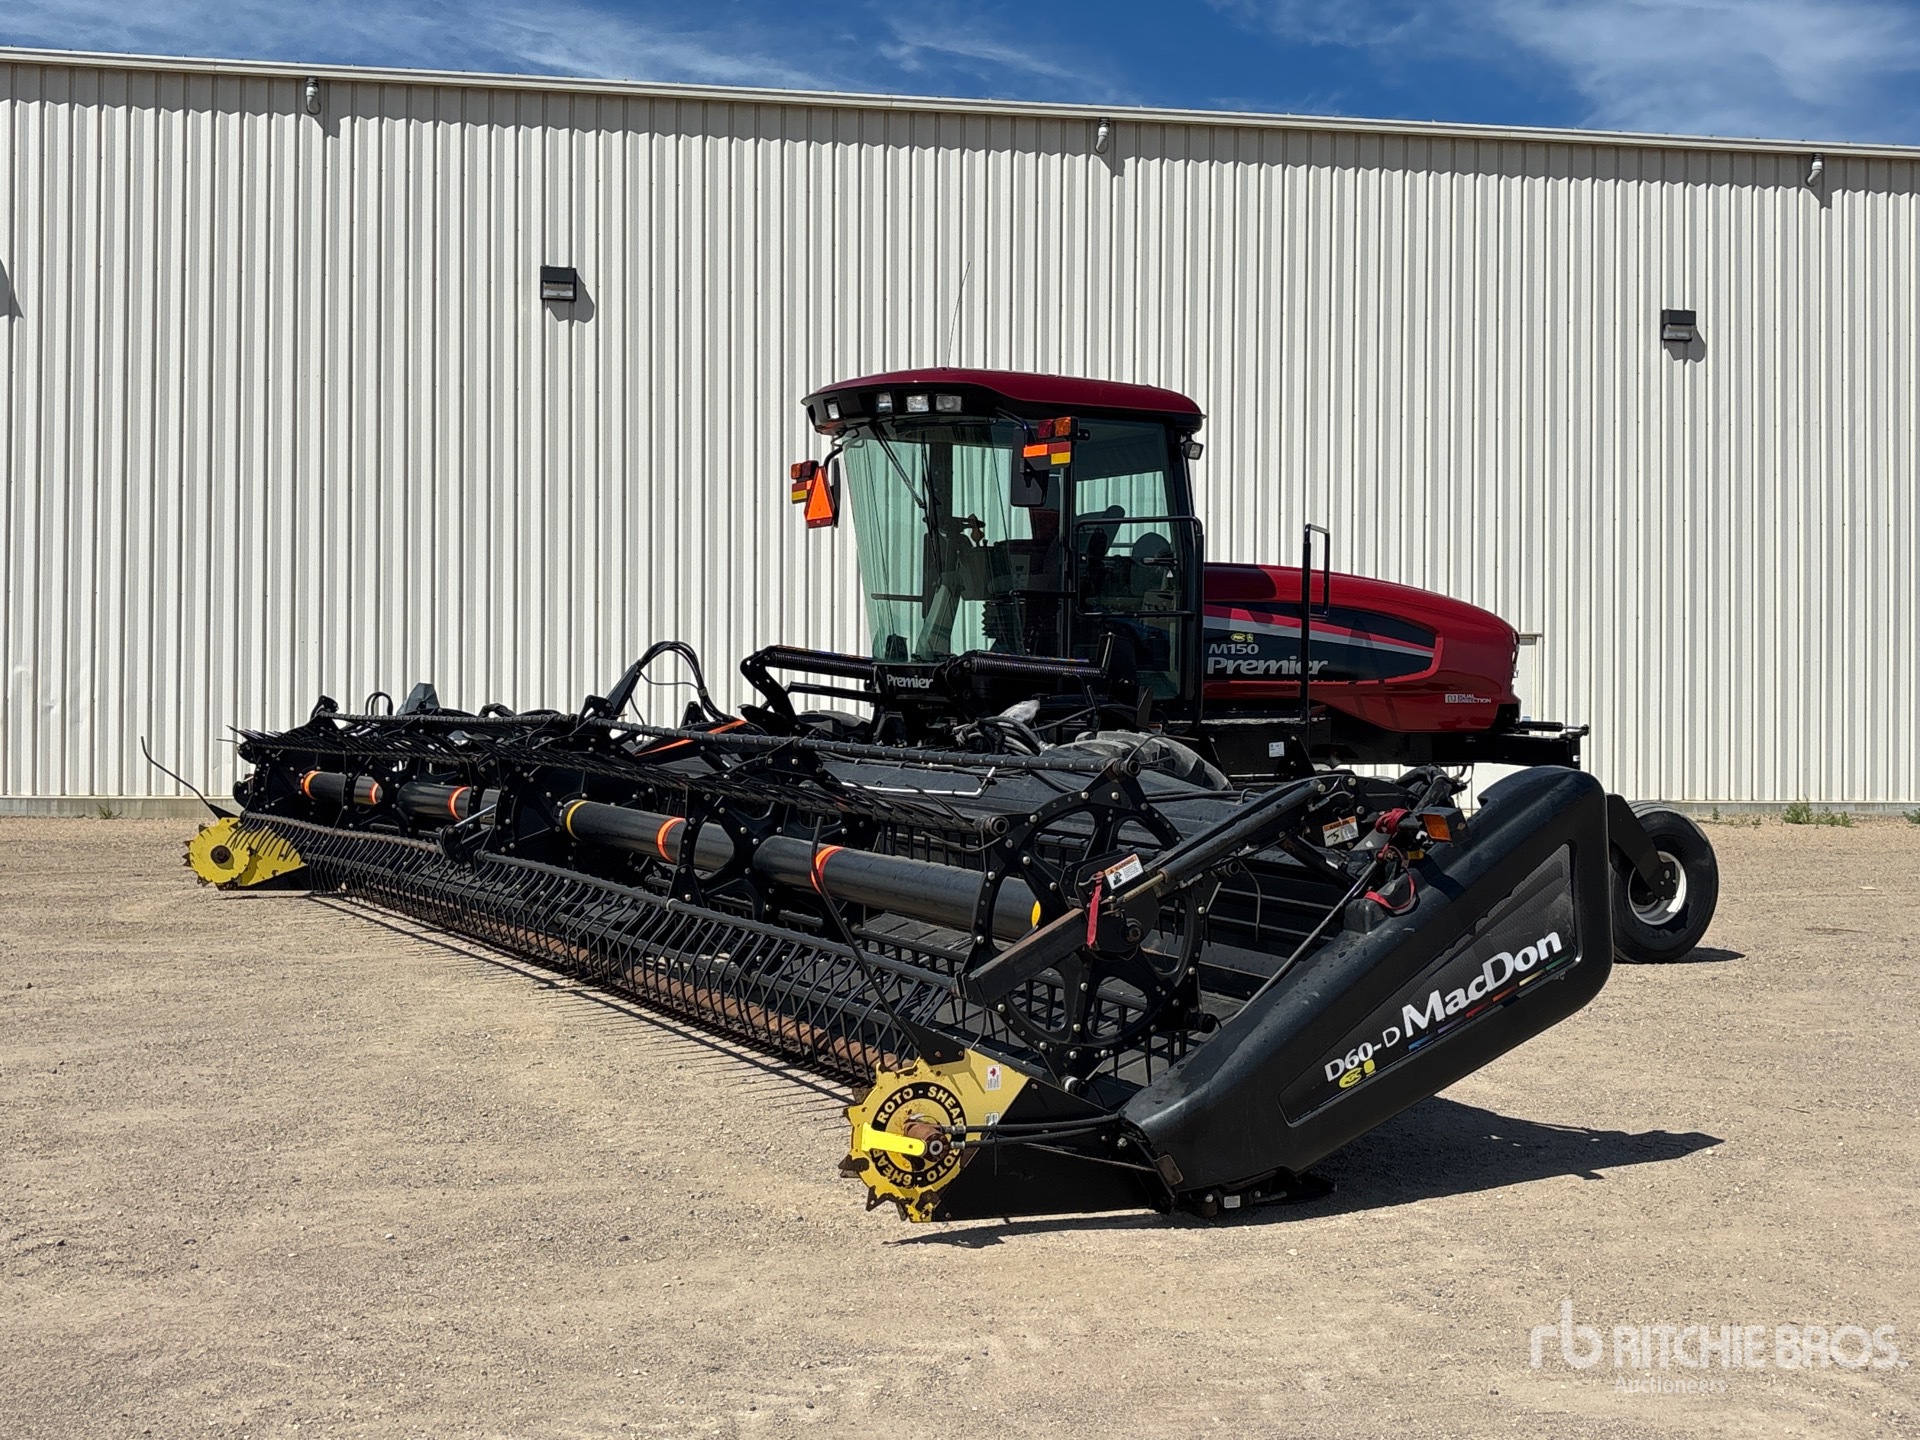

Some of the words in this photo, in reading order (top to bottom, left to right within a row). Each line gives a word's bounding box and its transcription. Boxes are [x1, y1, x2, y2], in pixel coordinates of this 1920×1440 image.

[1208, 643, 1260, 655] M150
[886, 673, 934, 689] Premier
[1401, 931, 1563, 1039] MacDon
